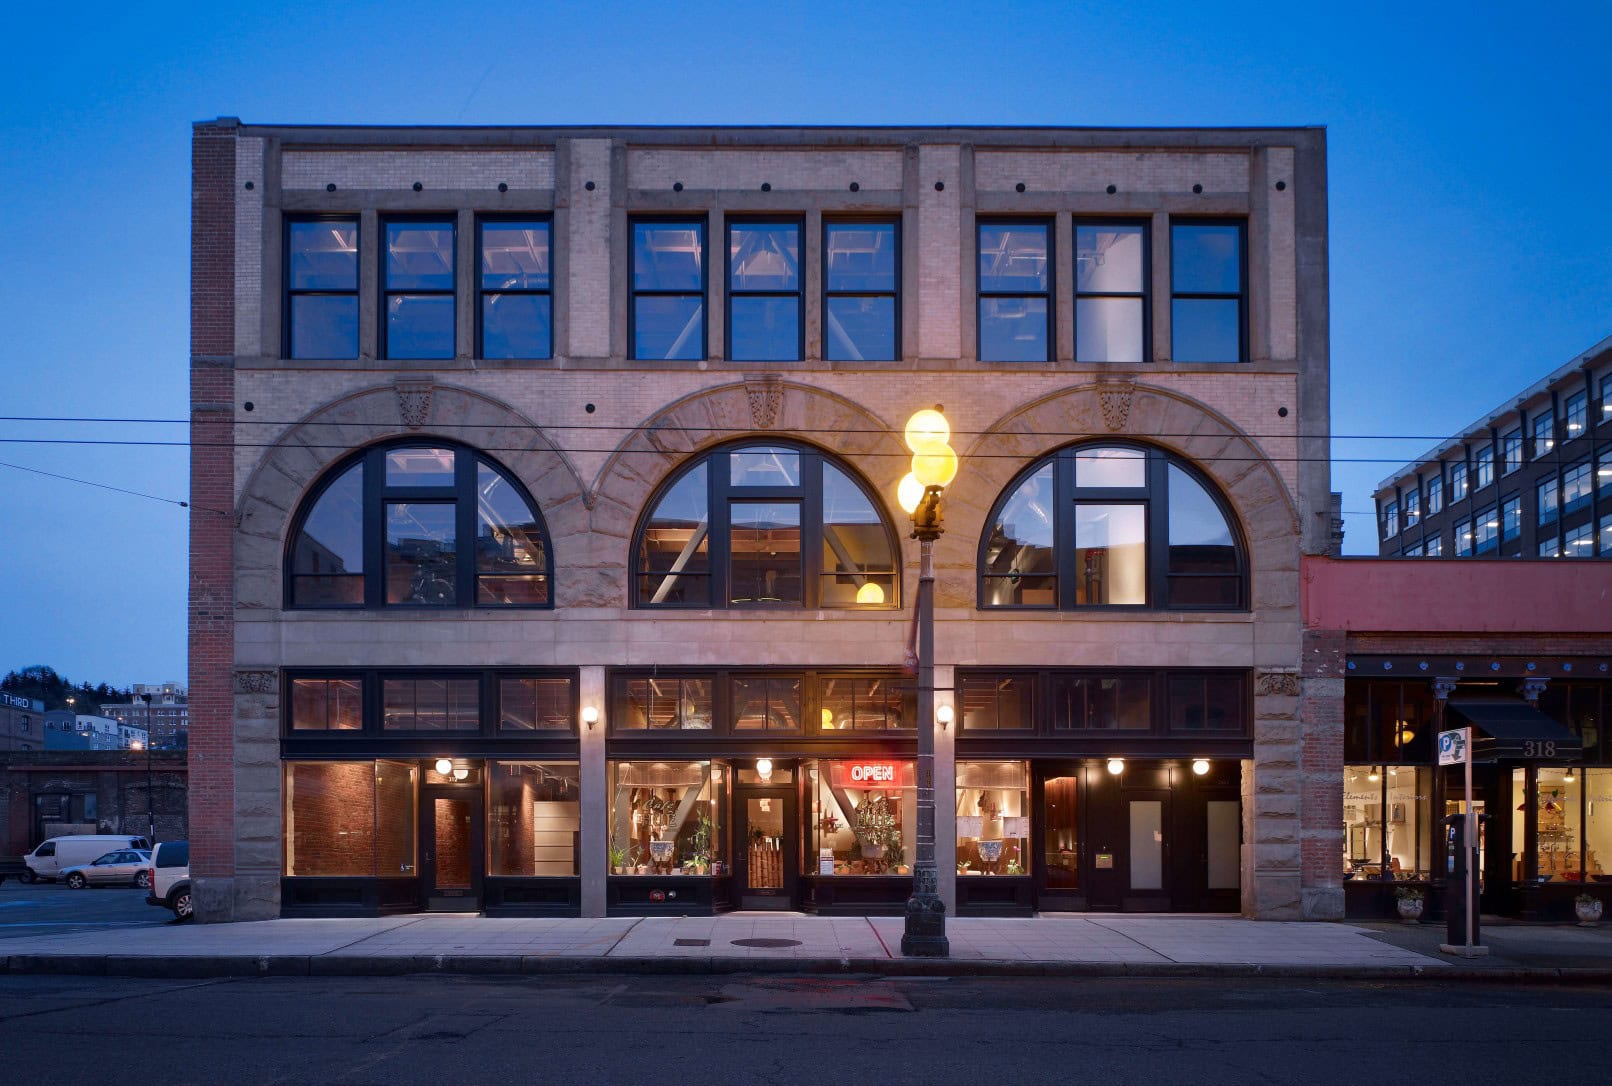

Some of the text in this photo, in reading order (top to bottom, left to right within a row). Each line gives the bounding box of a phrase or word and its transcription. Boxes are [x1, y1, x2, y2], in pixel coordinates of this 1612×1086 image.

[3, 694, 29, 708] THIRD
[1524, 740, 1556, 757] 318
[851, 765, 893, 781] OPEN
[1450, 827, 1456, 839] P
